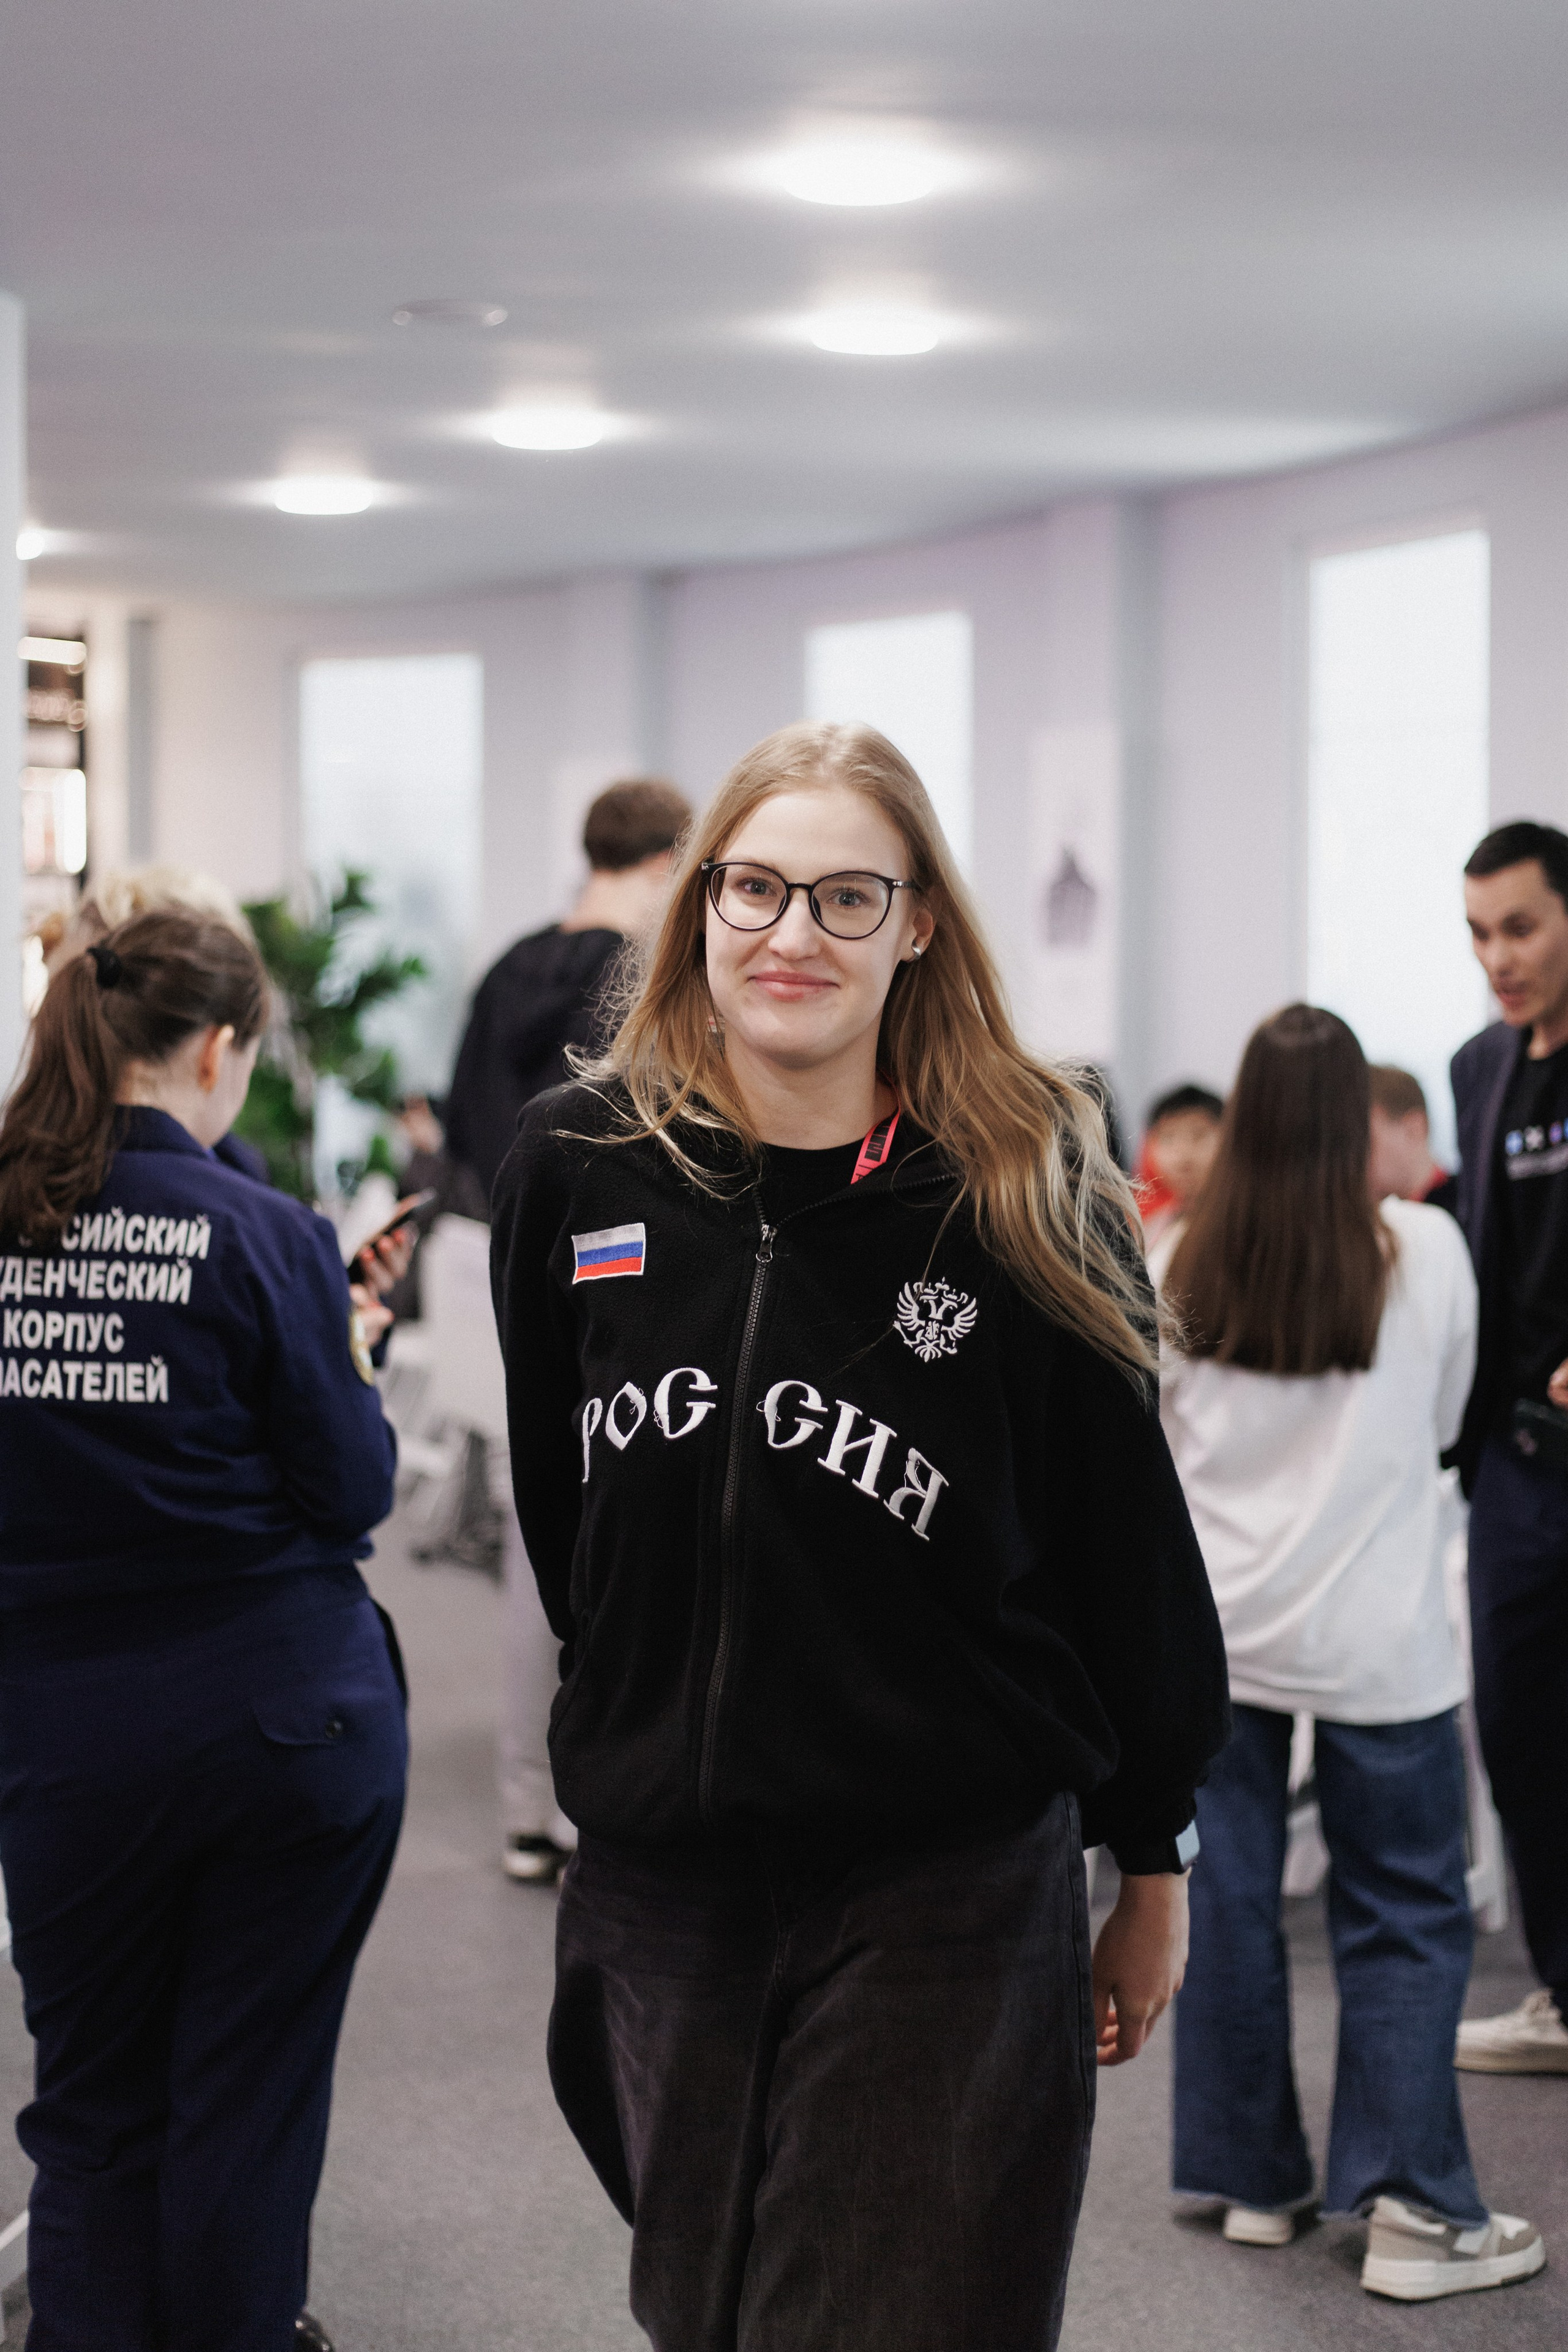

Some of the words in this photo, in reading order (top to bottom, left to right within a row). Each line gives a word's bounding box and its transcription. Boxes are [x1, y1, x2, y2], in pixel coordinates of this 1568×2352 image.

[18, 1206, 212, 1260] СИЙСКИЙ
[0, 1256, 193, 1305] ДЕНЧЕСКИЙ
[2, 1308, 125, 1354] КОРПУС
[0, 1354, 169, 1403] АСАТЕЛЕЙ
